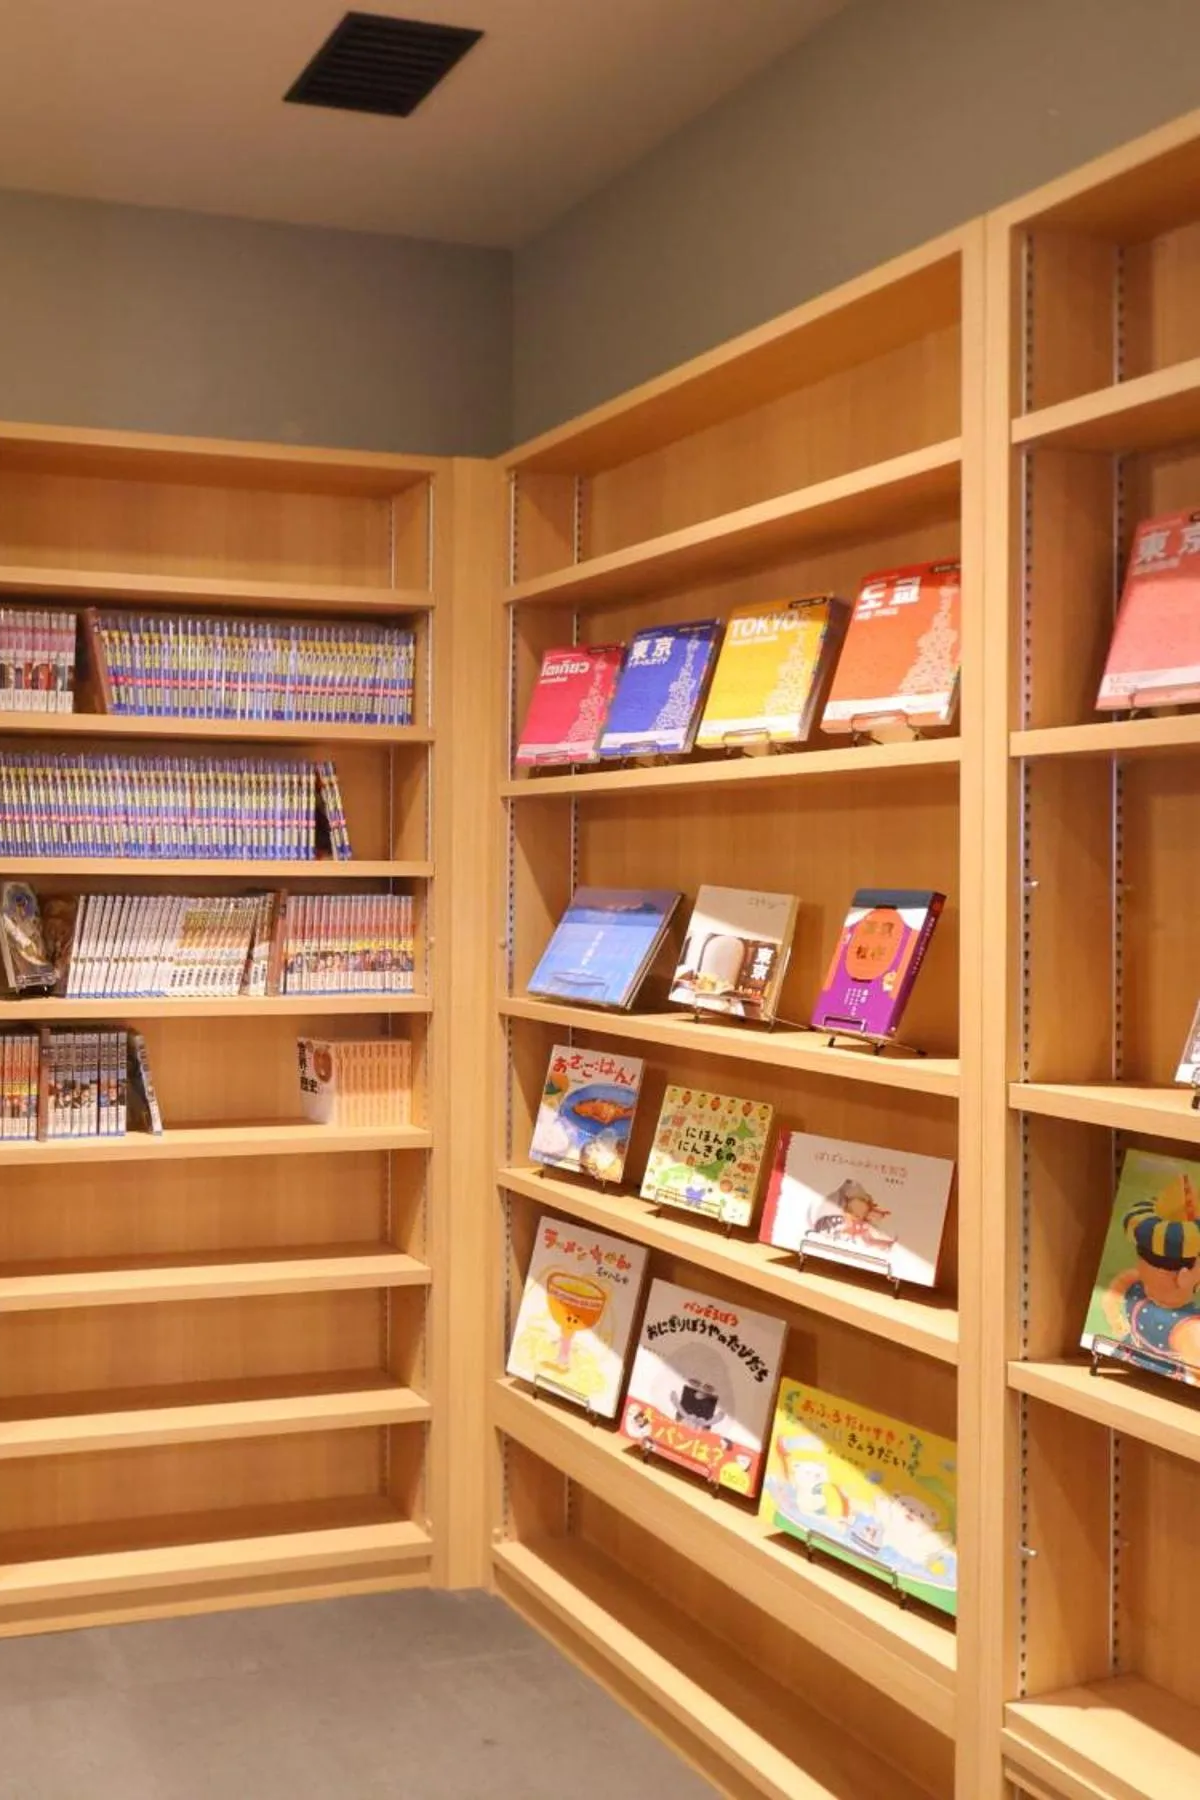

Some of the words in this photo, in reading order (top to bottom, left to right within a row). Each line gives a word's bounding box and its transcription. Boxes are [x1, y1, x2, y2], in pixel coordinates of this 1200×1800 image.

[730, 610, 800, 638] TOKYO
[631, 636, 676, 659] 東京
[685, 1127, 737, 1148] にほんの
[678, 1139, 737, 1163] にんきもの
[683, 1301, 739, 1326] パンどろぼう
[646, 1314, 769, 1383] おにぎりぼうやのたびだち
